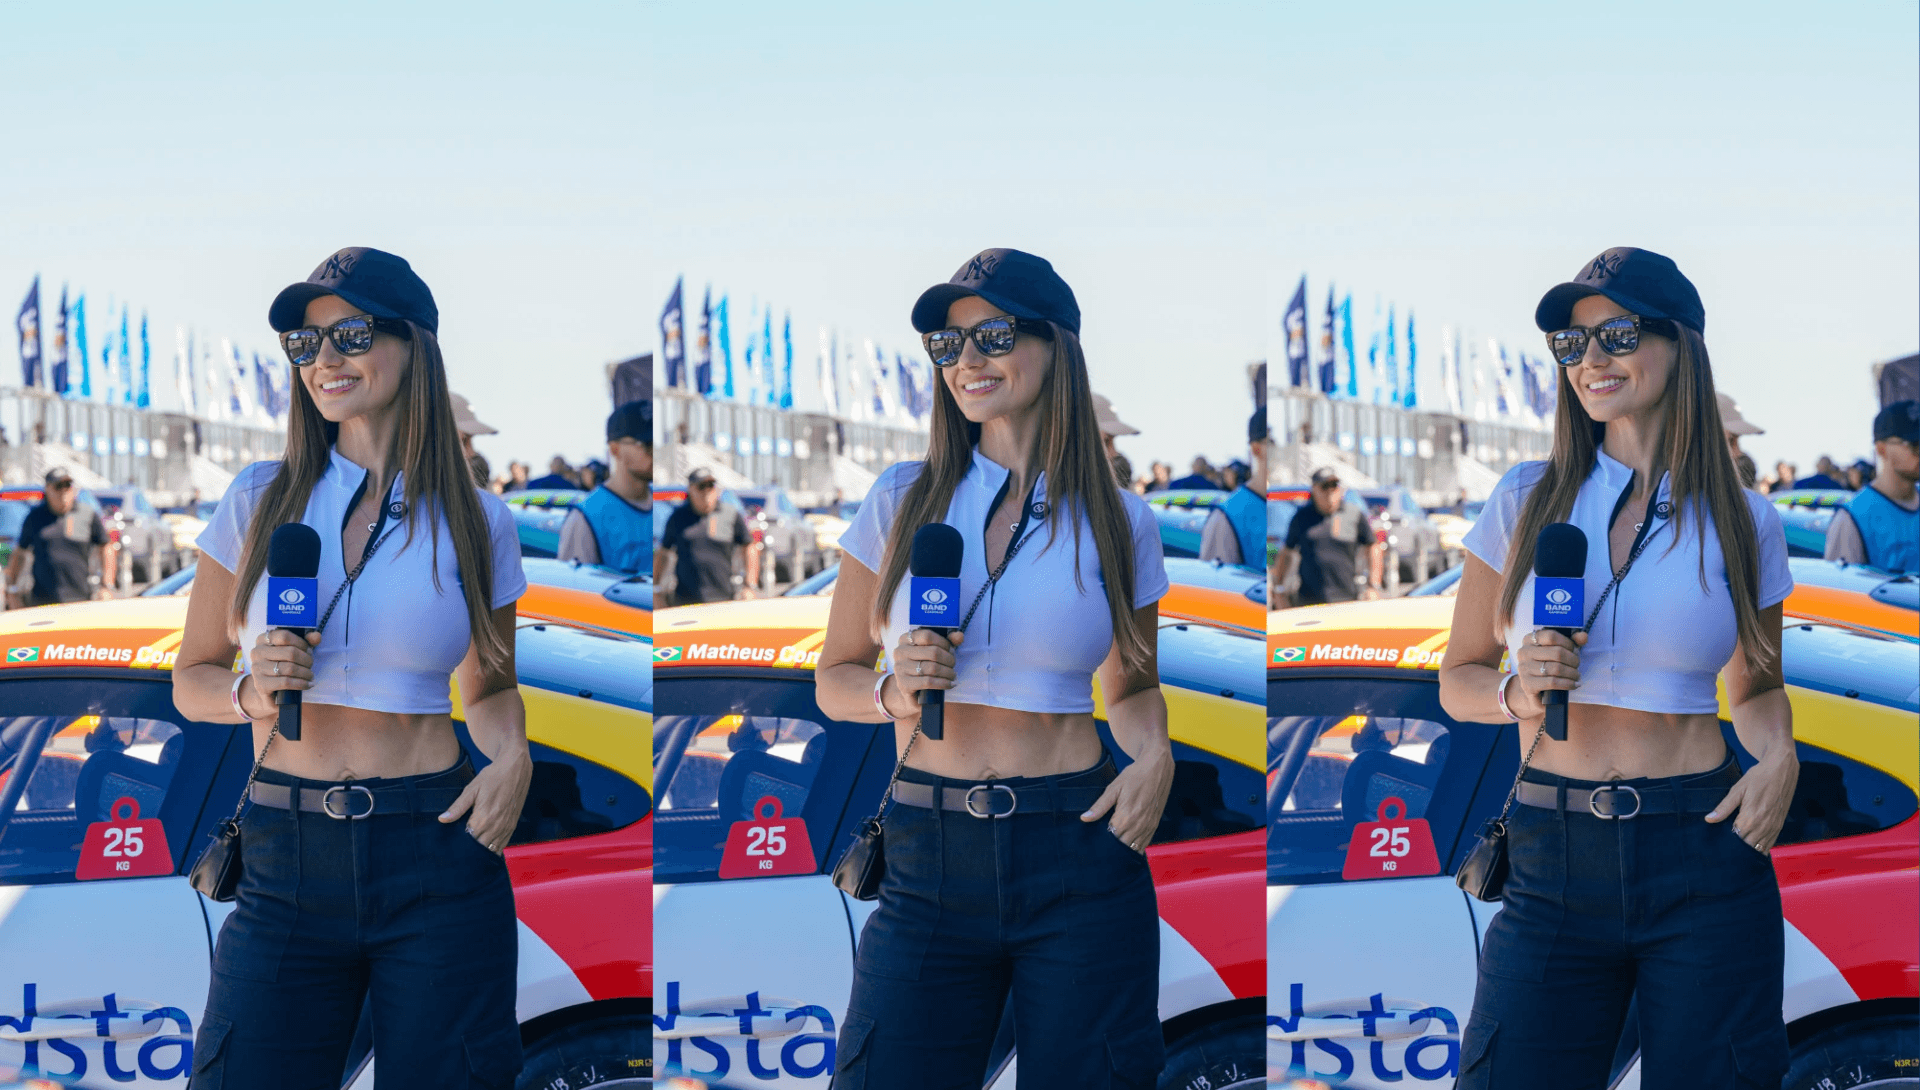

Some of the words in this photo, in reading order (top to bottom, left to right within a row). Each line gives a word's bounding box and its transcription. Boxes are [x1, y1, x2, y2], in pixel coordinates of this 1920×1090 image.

[320, 253, 357, 280] NY
[962, 254, 999, 281] NY
[1586, 253, 1623, 280] NY
[43, 644, 132, 661] Matheus
[687, 644, 775, 661] Matheus
[1310, 644, 1399, 661] Matheus
[103, 826, 144, 857] 25
[746, 825, 787, 856] 25
[1370, 826, 1410, 857] 25
[116, 861, 130, 871] KG
[759, 859, 773, 869] KG
[1382, 861, 1397, 871] KG
